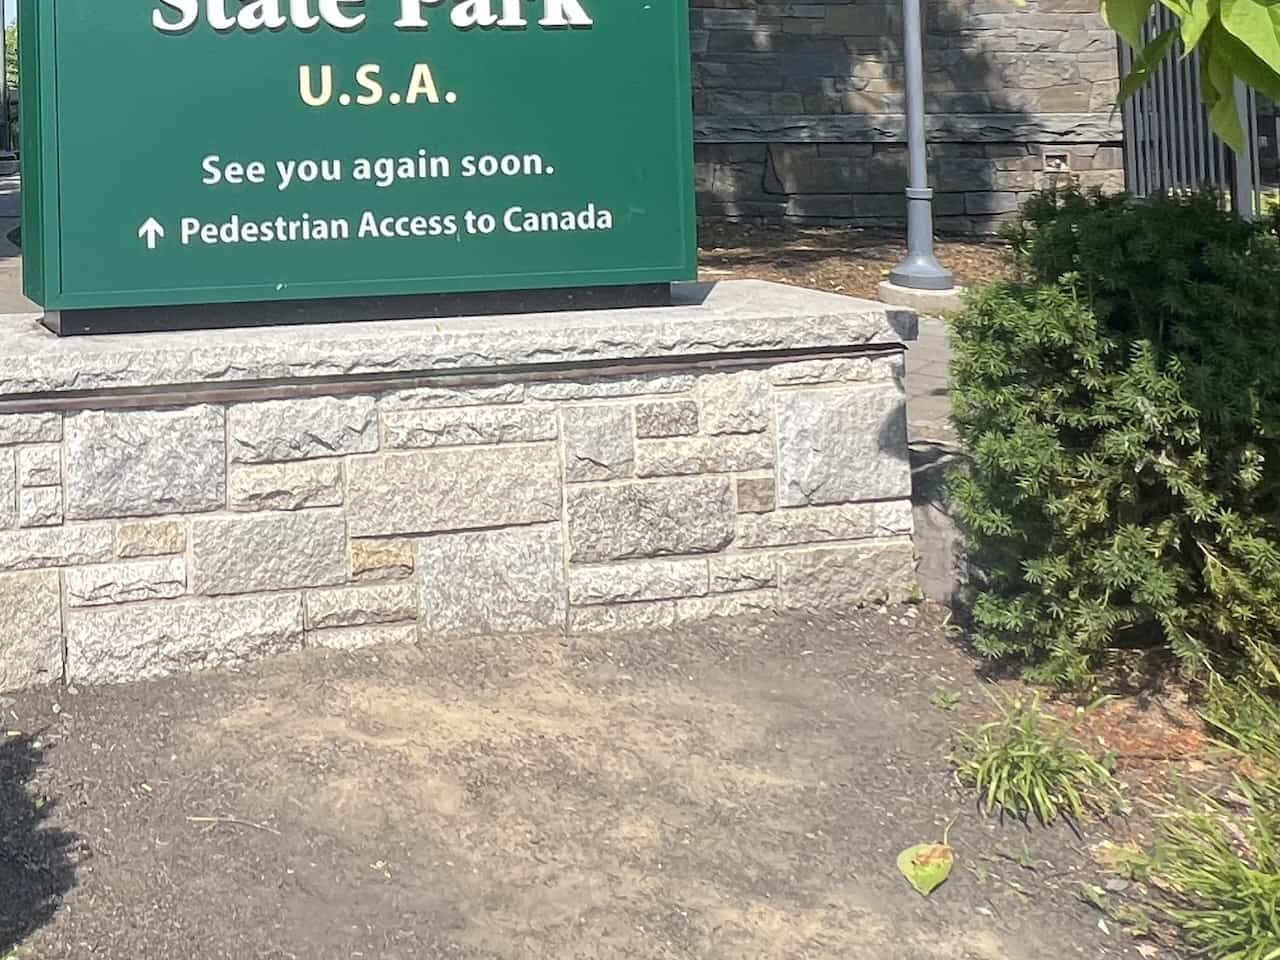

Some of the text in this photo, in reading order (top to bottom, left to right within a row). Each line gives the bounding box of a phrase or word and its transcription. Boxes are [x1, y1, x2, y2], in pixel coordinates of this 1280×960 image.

[299, 63, 457, 107] U.S.A.
[202, 149, 554, 191] See you again soon.
[181, 203, 613, 245] Pedestrian Access to Canada
